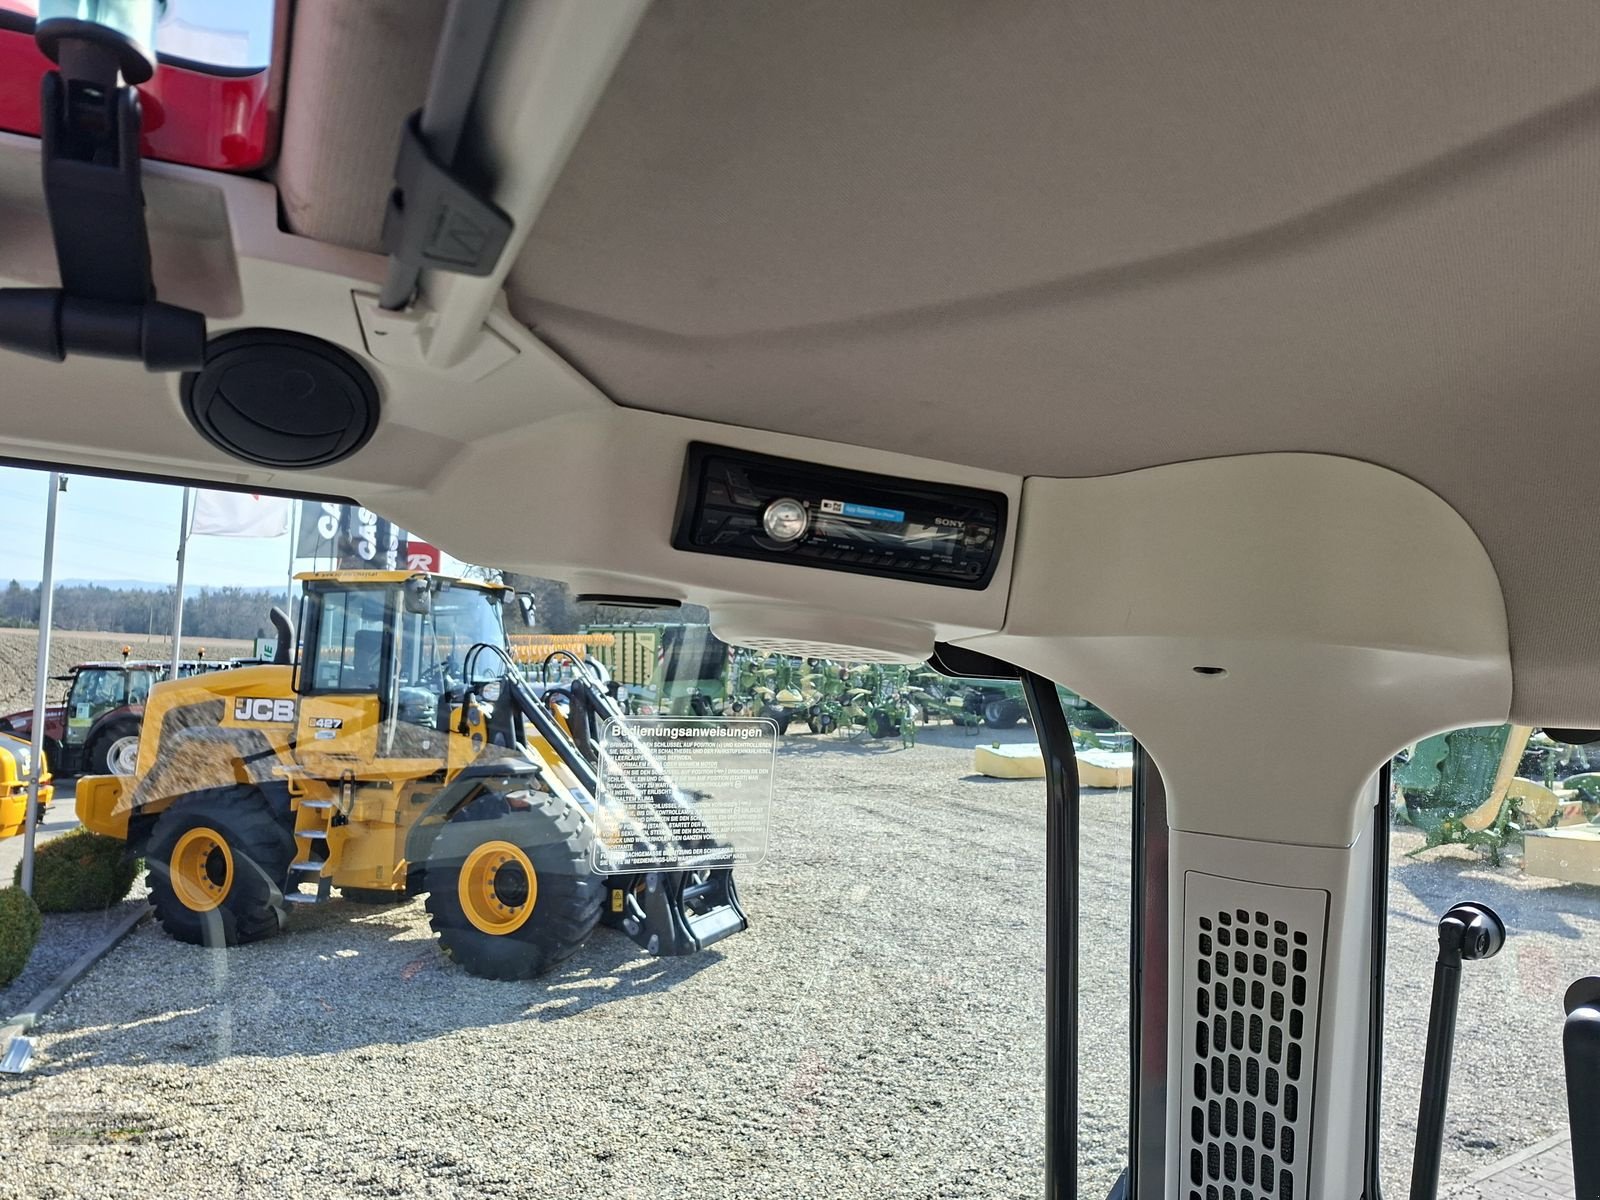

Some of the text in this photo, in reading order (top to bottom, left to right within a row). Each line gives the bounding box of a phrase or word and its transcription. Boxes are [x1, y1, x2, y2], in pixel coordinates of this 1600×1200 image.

[935, 517, 965, 528] SONY
[235, 698, 295, 722] JCB
[611, 724, 763, 741] Bedienungsanweisungen
[679, 815, 690, 823] DEN
[691, 821, 702, 829] DER
[682, 828, 692, 836] DEN
[623, 836, 635, 844] UND
[683, 834, 702, 842] GANZEN
[693, 848, 703, 856] DER
